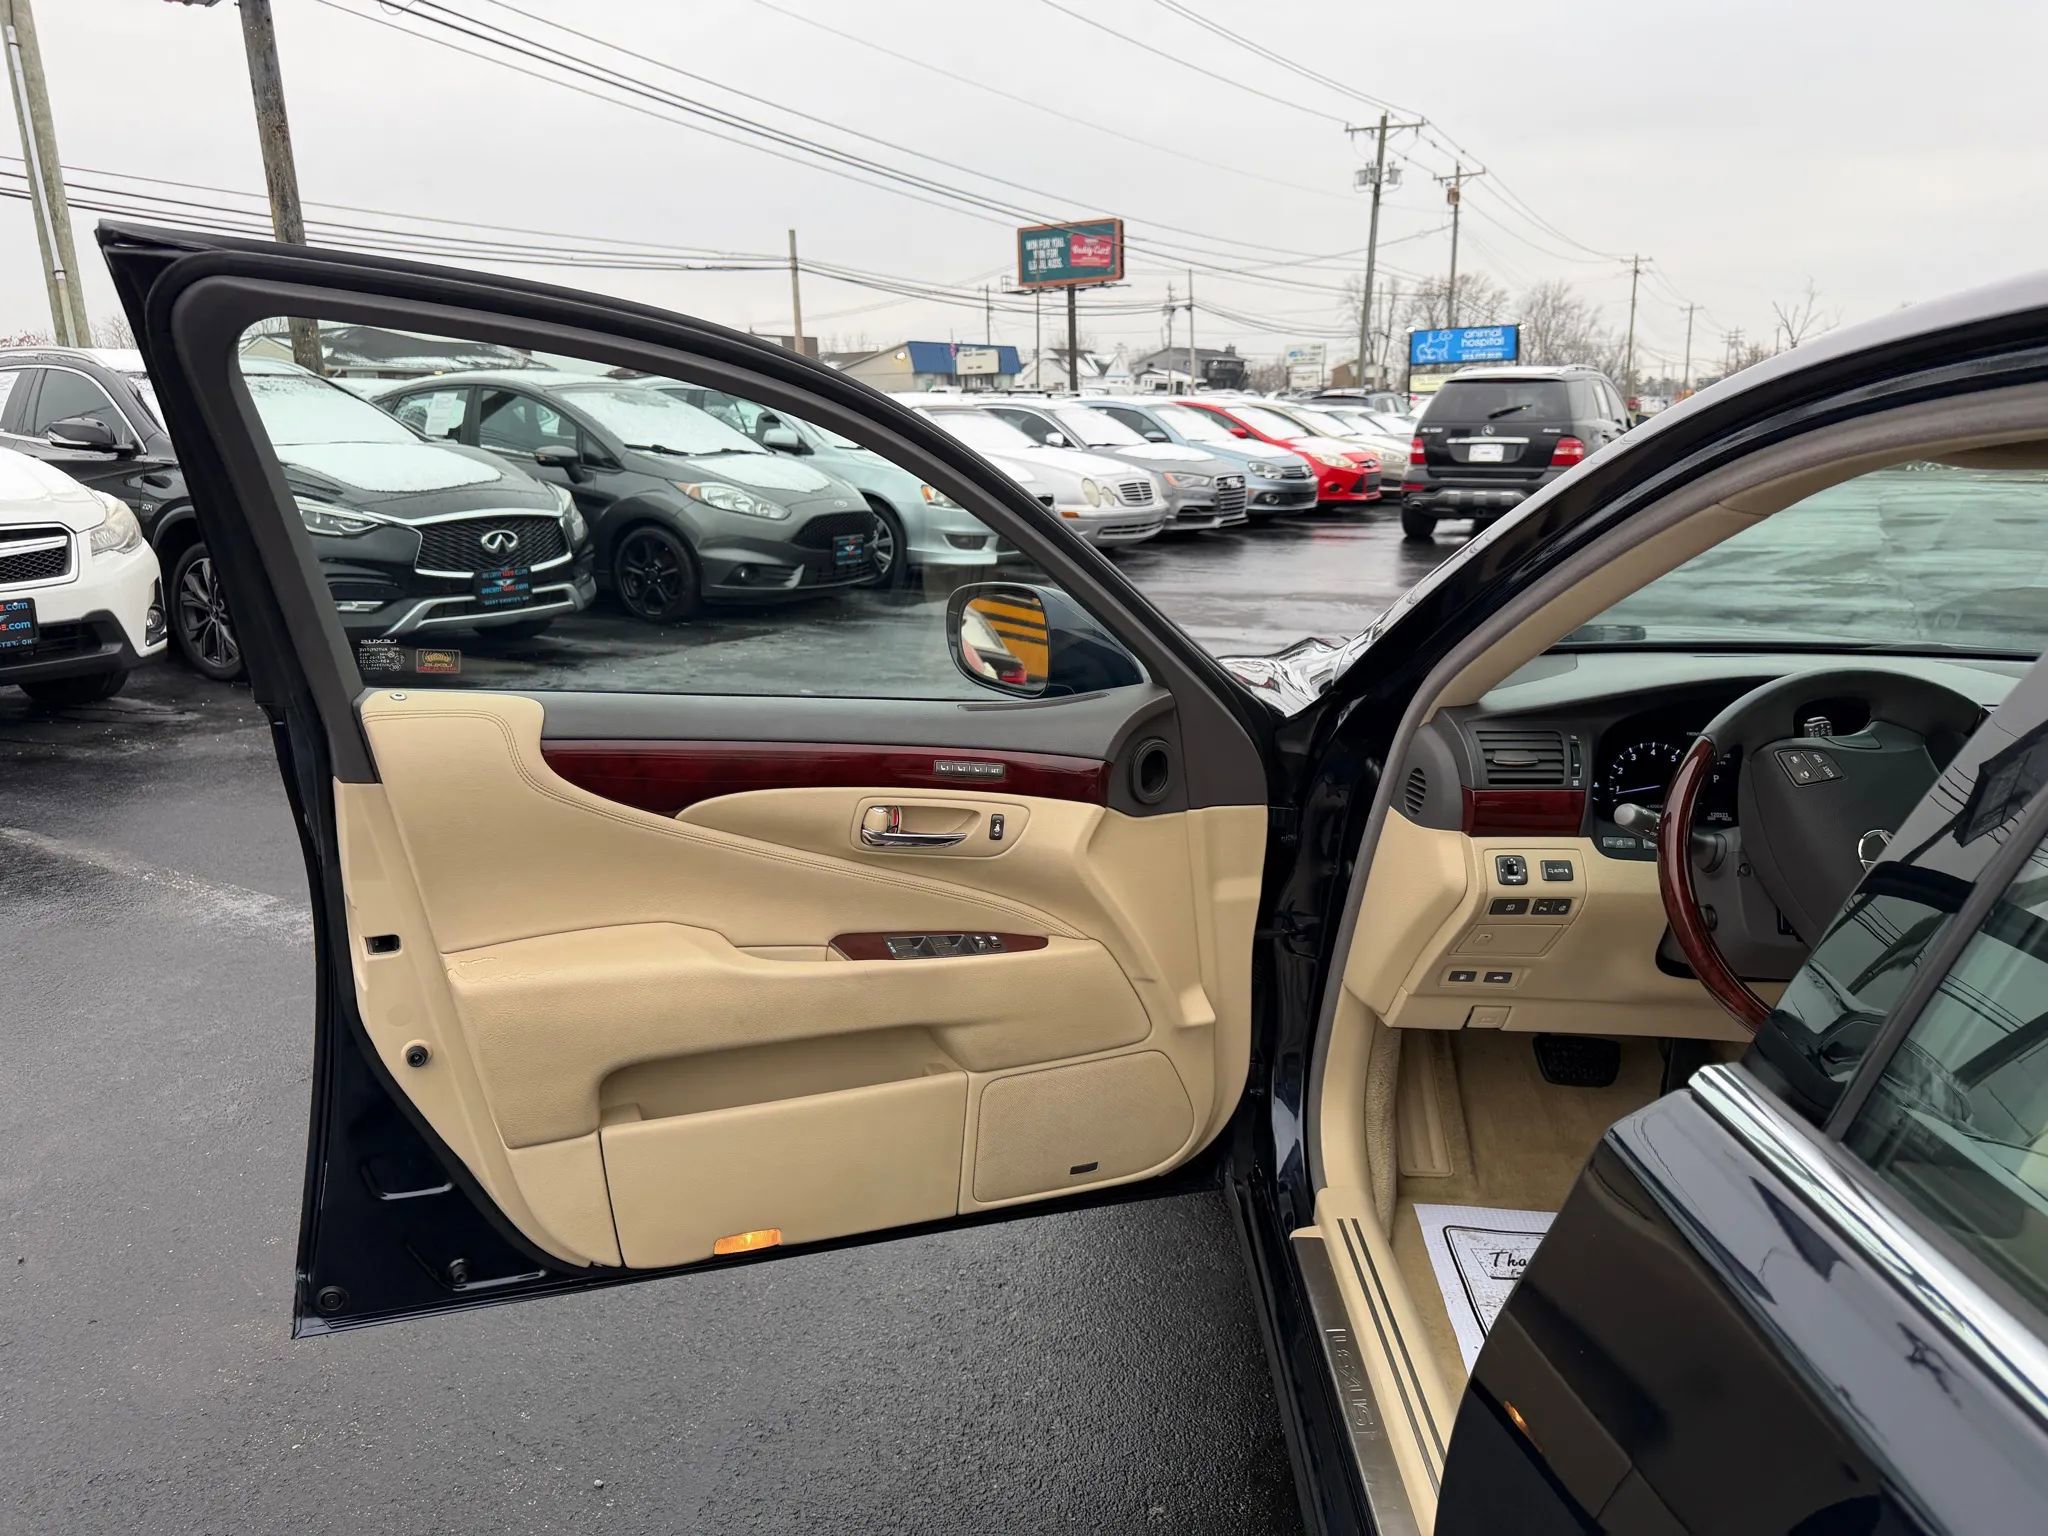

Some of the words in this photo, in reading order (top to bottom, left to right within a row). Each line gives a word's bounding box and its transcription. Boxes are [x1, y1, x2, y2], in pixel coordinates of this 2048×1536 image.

[1463, 328, 1502, 339] animal
[1461, 337, 1505, 347] hospital
[1618, 767, 1623, 775] 2
[1713, 775, 1719, 783] P
